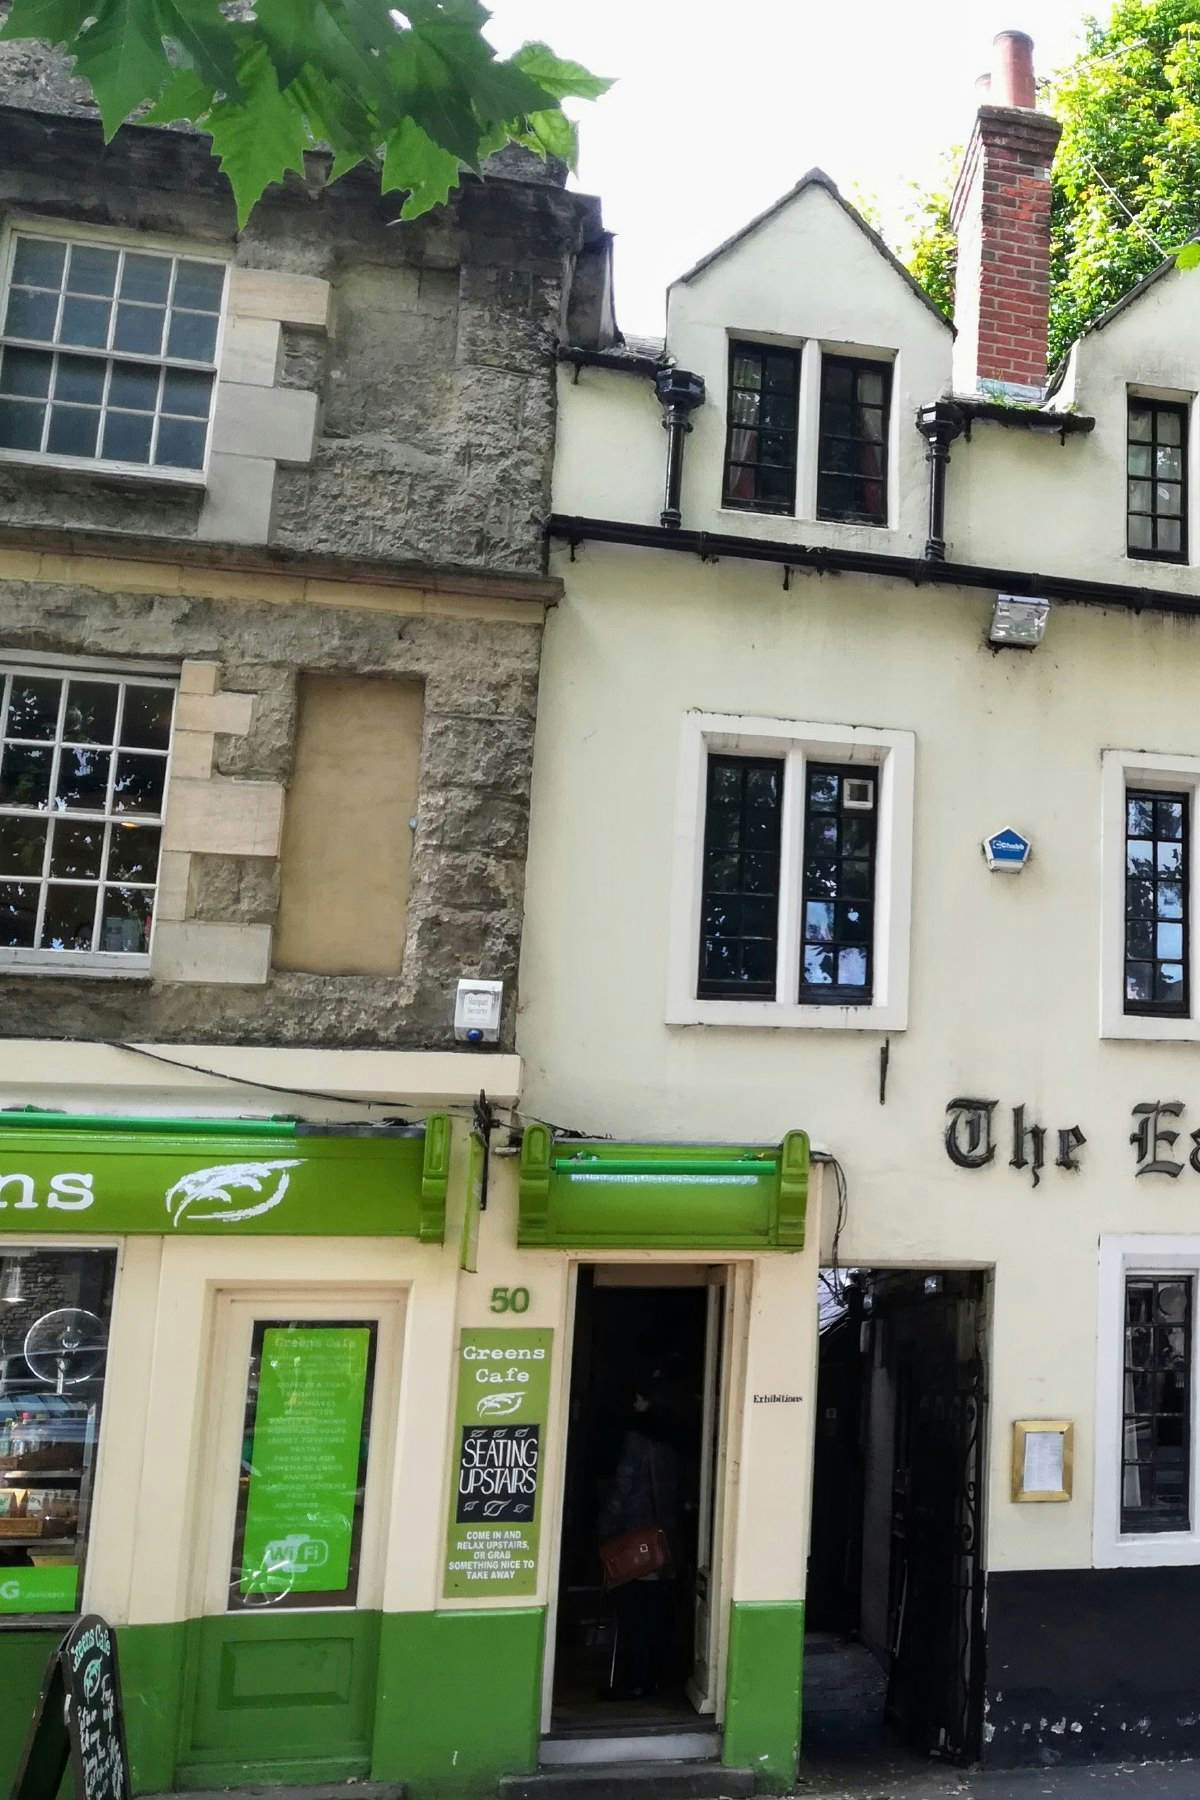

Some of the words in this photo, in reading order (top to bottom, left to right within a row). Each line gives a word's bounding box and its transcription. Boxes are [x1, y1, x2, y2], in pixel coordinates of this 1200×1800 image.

[944, 1097, 1087, 1188] The
[490, 1287, 530, 1313] 50
[463, 1345, 545, 1360] Greens
[475, 1367, 529, 1383] Cafe
[462, 1438, 538, 1467] SEATING
[459, 1467, 537, 1495] UPSTAIRS
[466, 1531, 491, 1540] COME
[493, 1531, 502, 1539] IN
[503, 1530, 521, 1539] AND
[457, 1541, 484, 1550] RELAX
[473, 1551, 486, 1560] OR
[487, 1550, 511, 1560] GRAB
[448, 1561, 499, 1570] SOMETHING
[500, 1560, 521, 1569] NICE
[523, 1559, 535, 1568] TO
[466, 1571, 489, 1580] TAKE
[490, 1570, 516, 1579] AWAY
